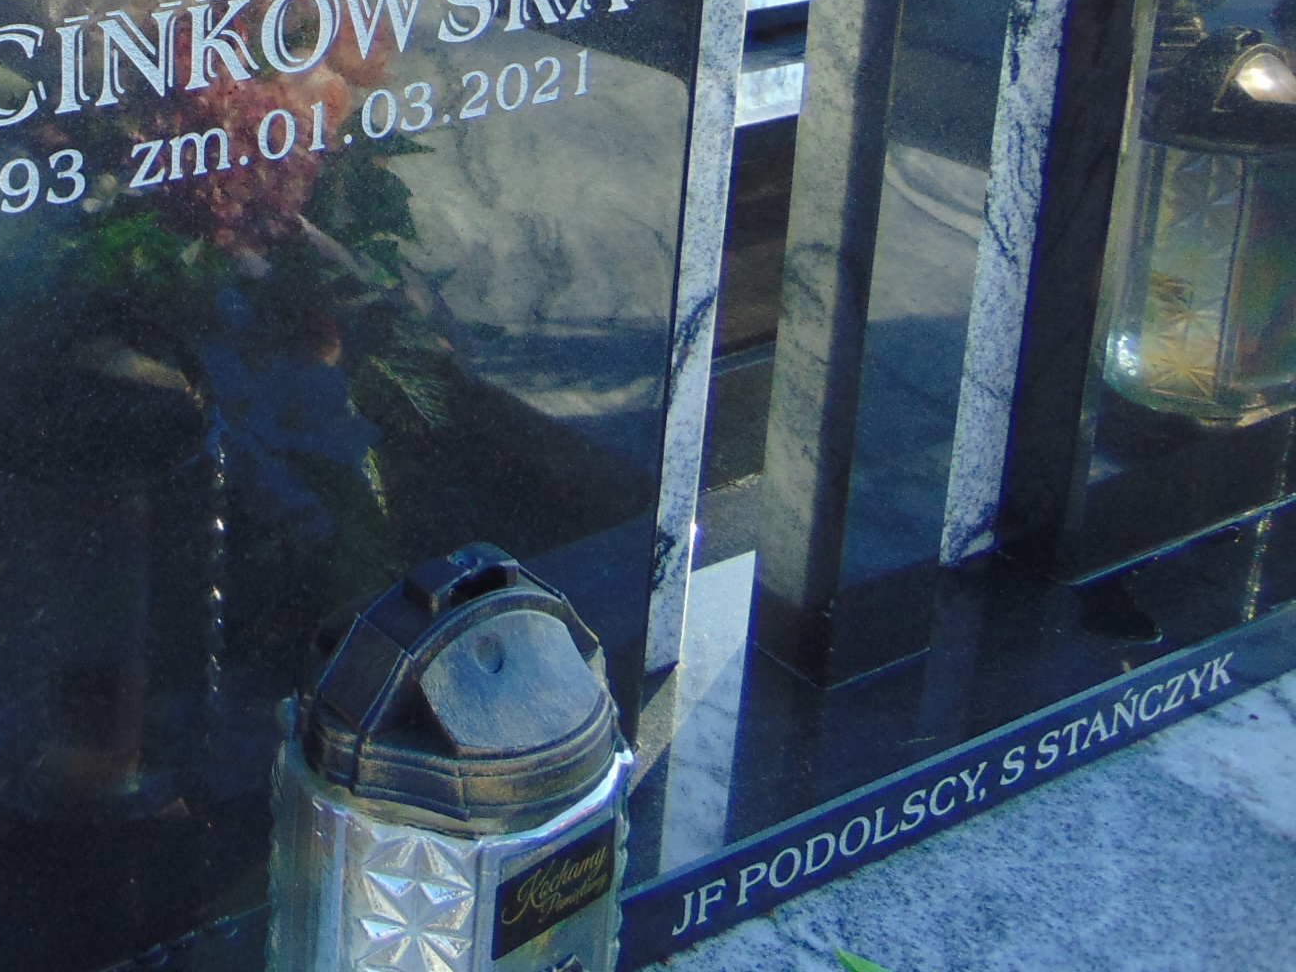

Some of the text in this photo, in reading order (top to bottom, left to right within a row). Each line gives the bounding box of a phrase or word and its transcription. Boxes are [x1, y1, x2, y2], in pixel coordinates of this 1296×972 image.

[671, 878, 726, 936] JF
[736, 761, 987, 906] PODOLSCY,
[1000, 745, 1026, 786] S
[1034, 651, 1234, 770] STAŃCZYK
